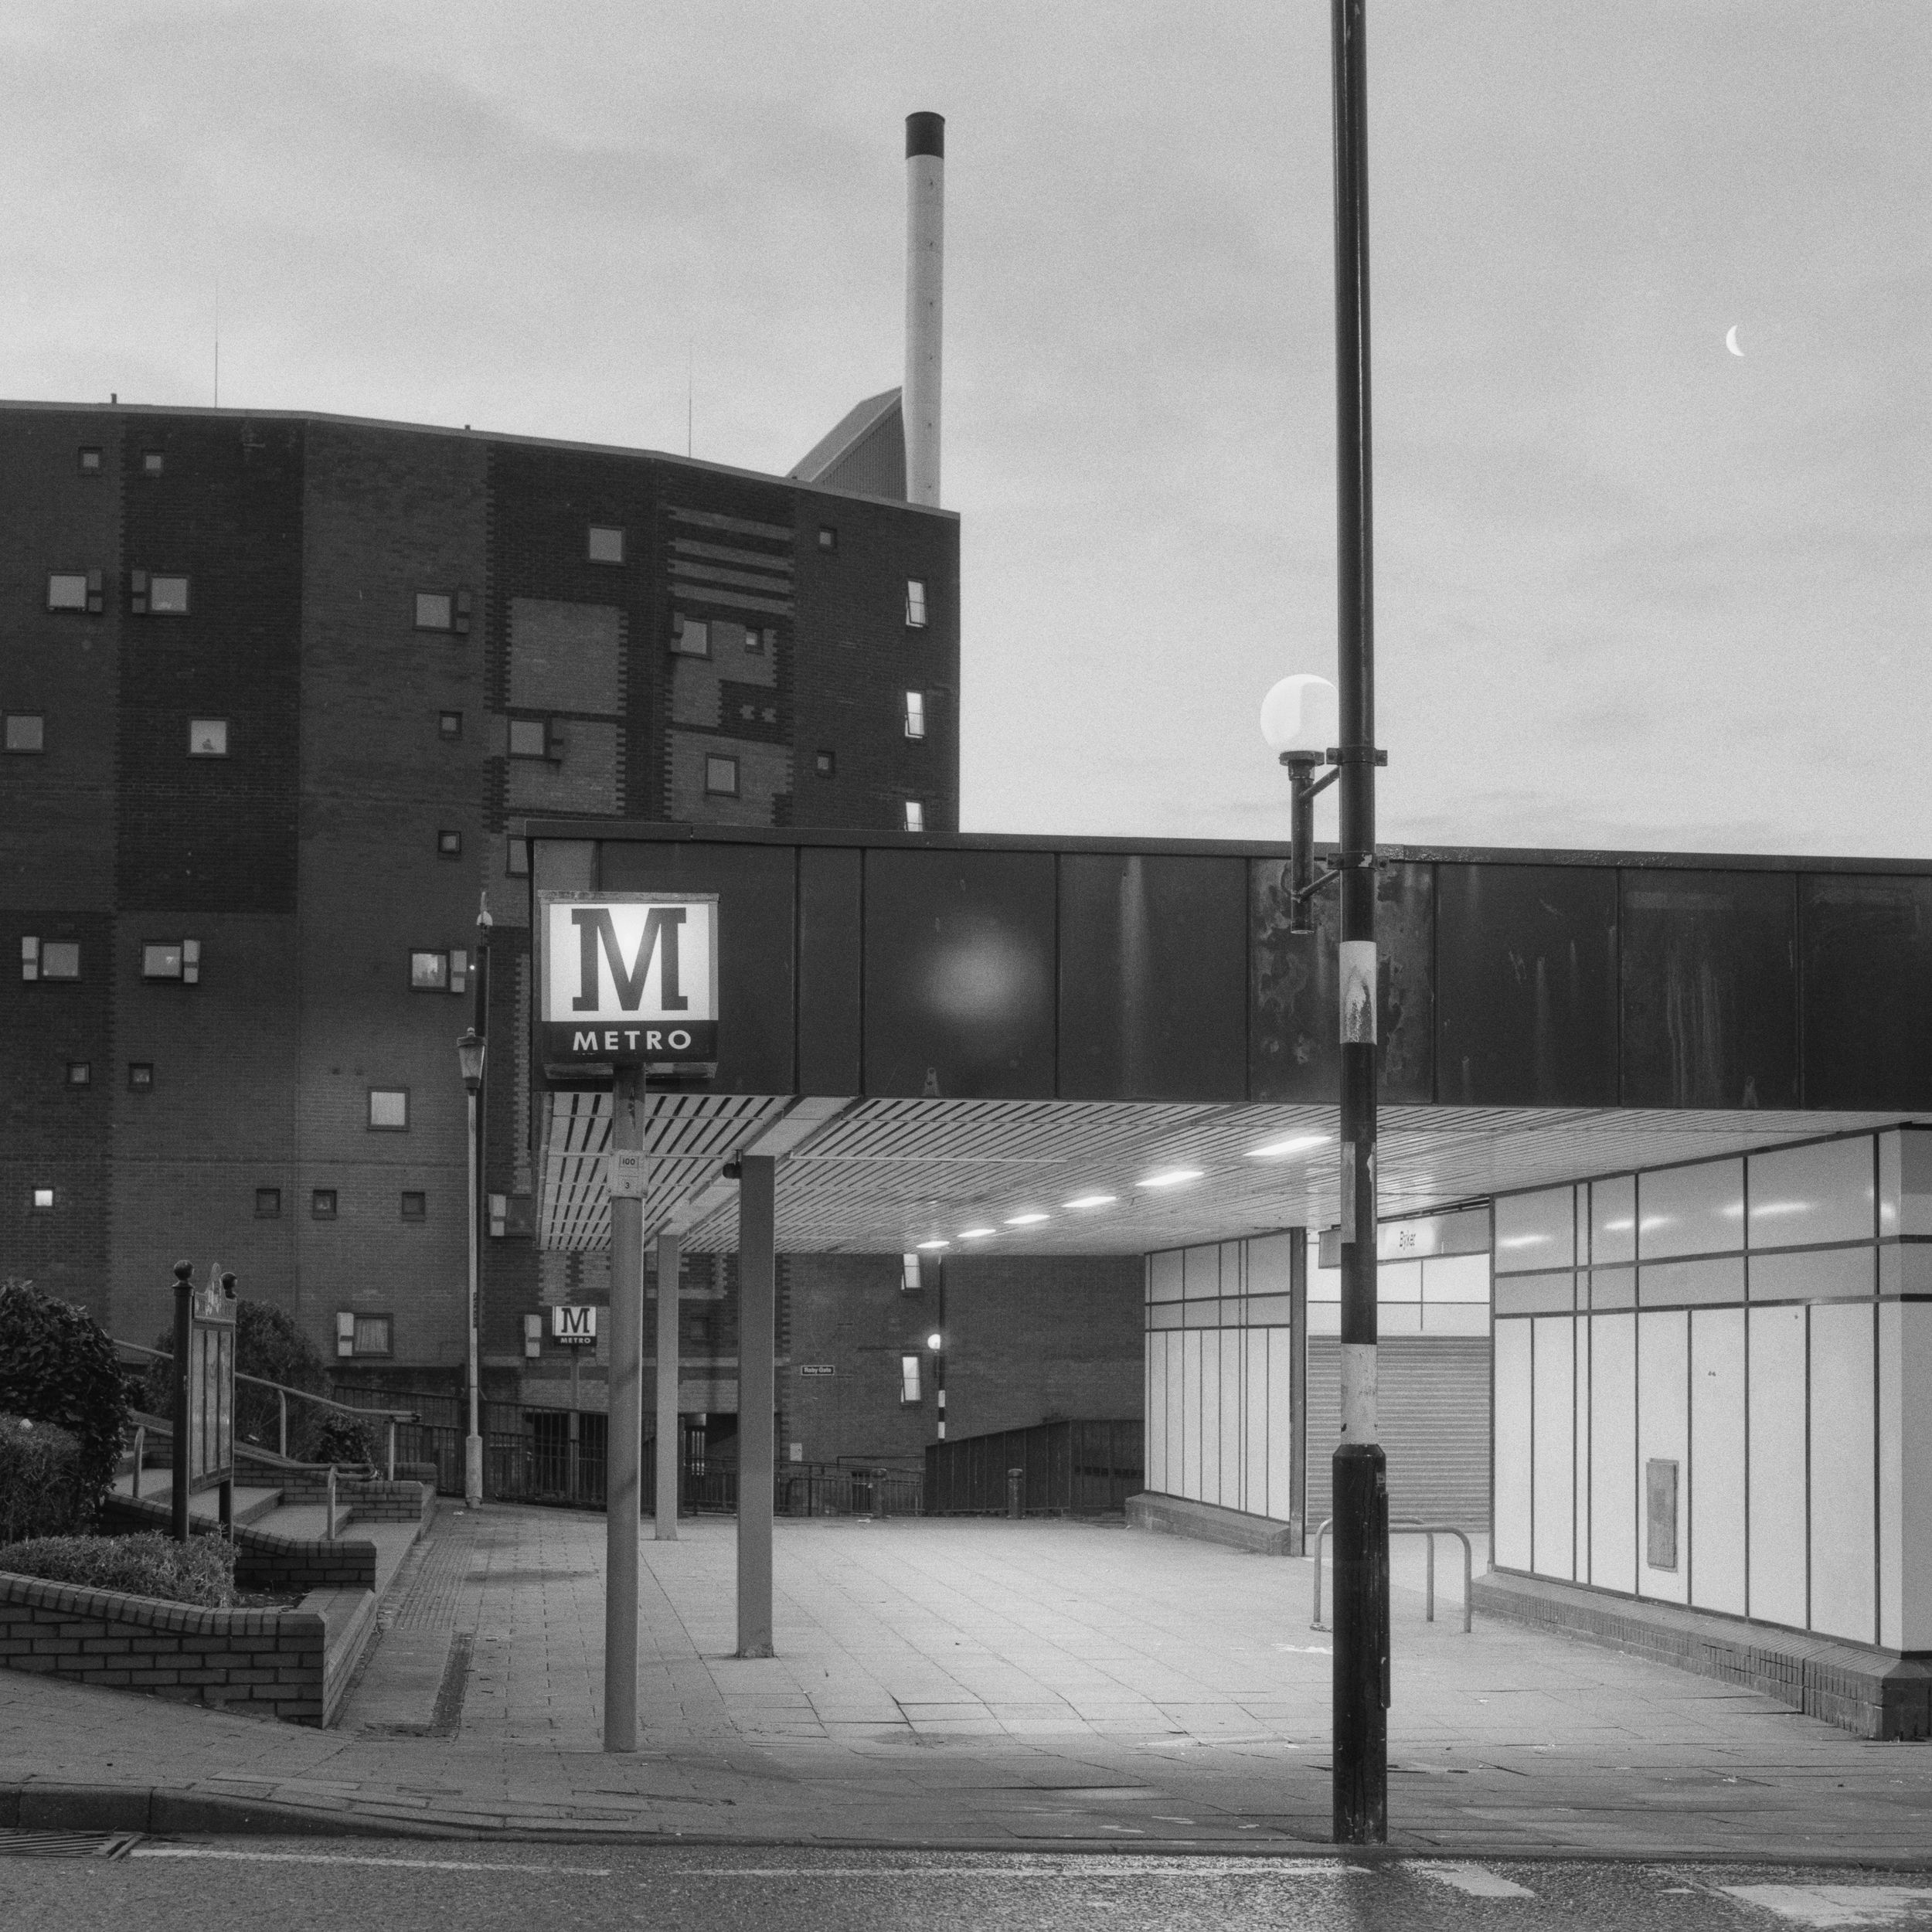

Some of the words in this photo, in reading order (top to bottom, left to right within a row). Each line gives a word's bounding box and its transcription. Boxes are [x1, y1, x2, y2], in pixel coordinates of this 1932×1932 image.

[571, 907, 689, 1012] M
[572, 1029, 692, 1051] METRO
[1399, 1230, 1416, 1250] Byker
[560, 1308, 590, 1334] M
